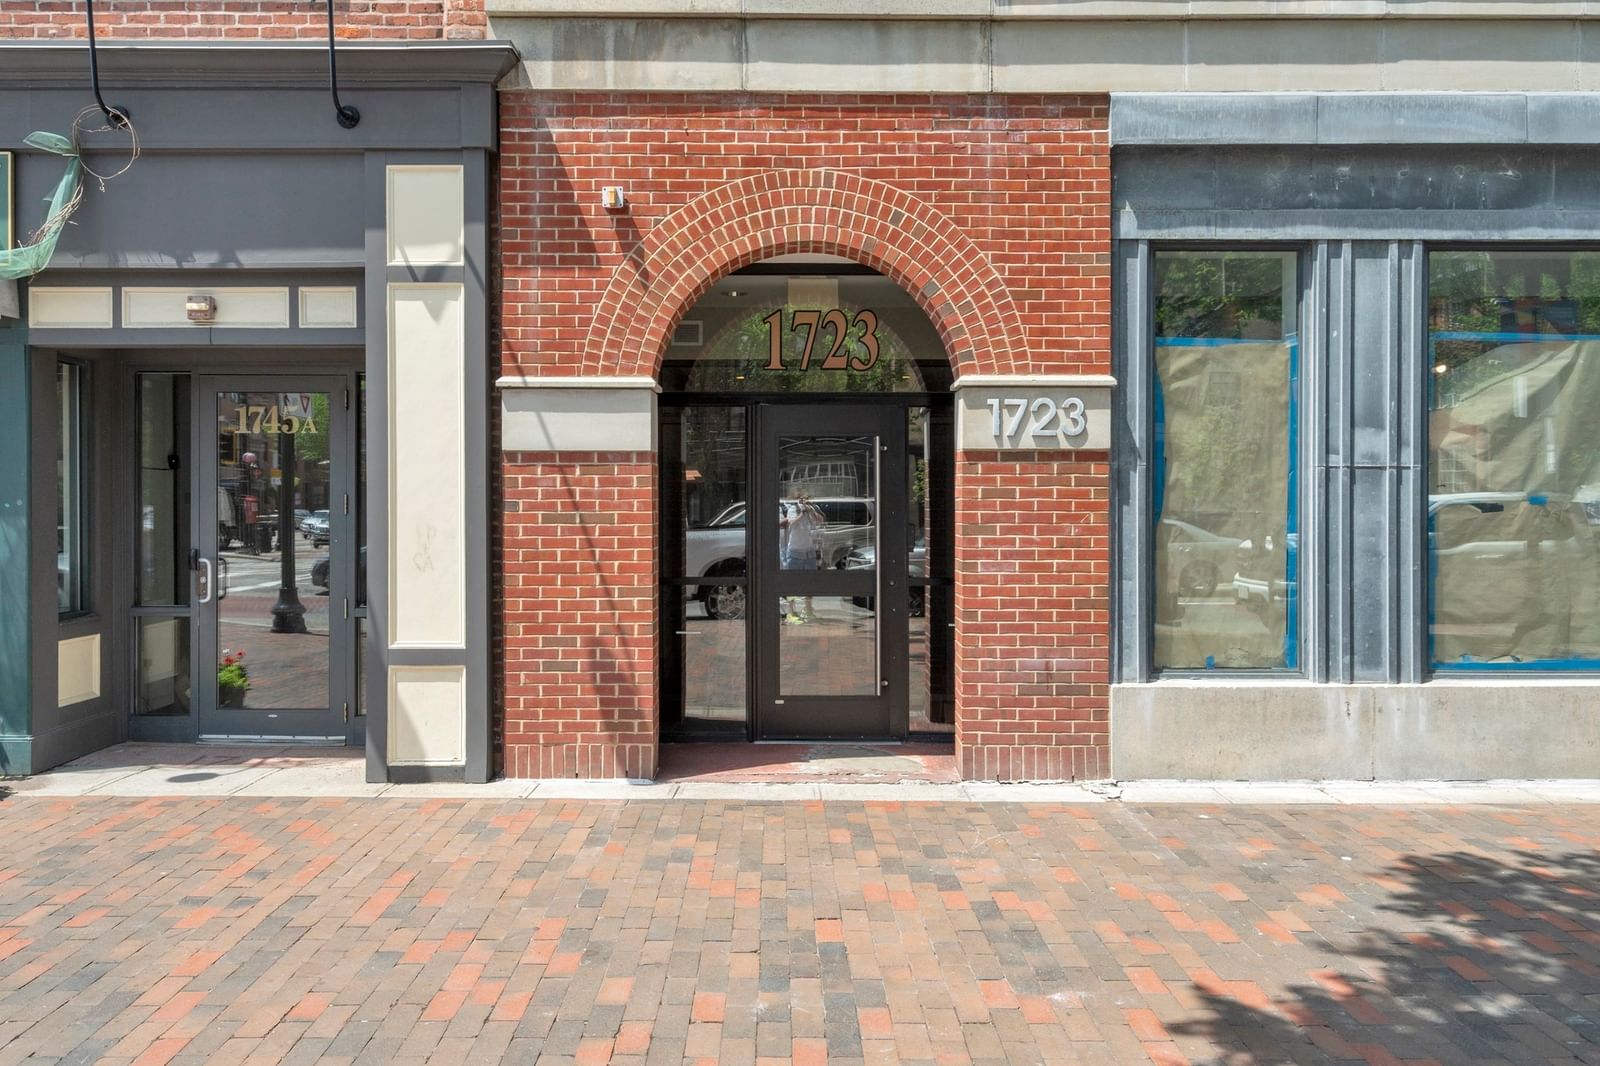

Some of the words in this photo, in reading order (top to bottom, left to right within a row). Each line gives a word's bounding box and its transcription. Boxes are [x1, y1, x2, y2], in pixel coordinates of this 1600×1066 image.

[762, 309, 880, 371] 1723
[234, 405, 318, 434] 1745A
[986, 397, 1086, 437] 1723
